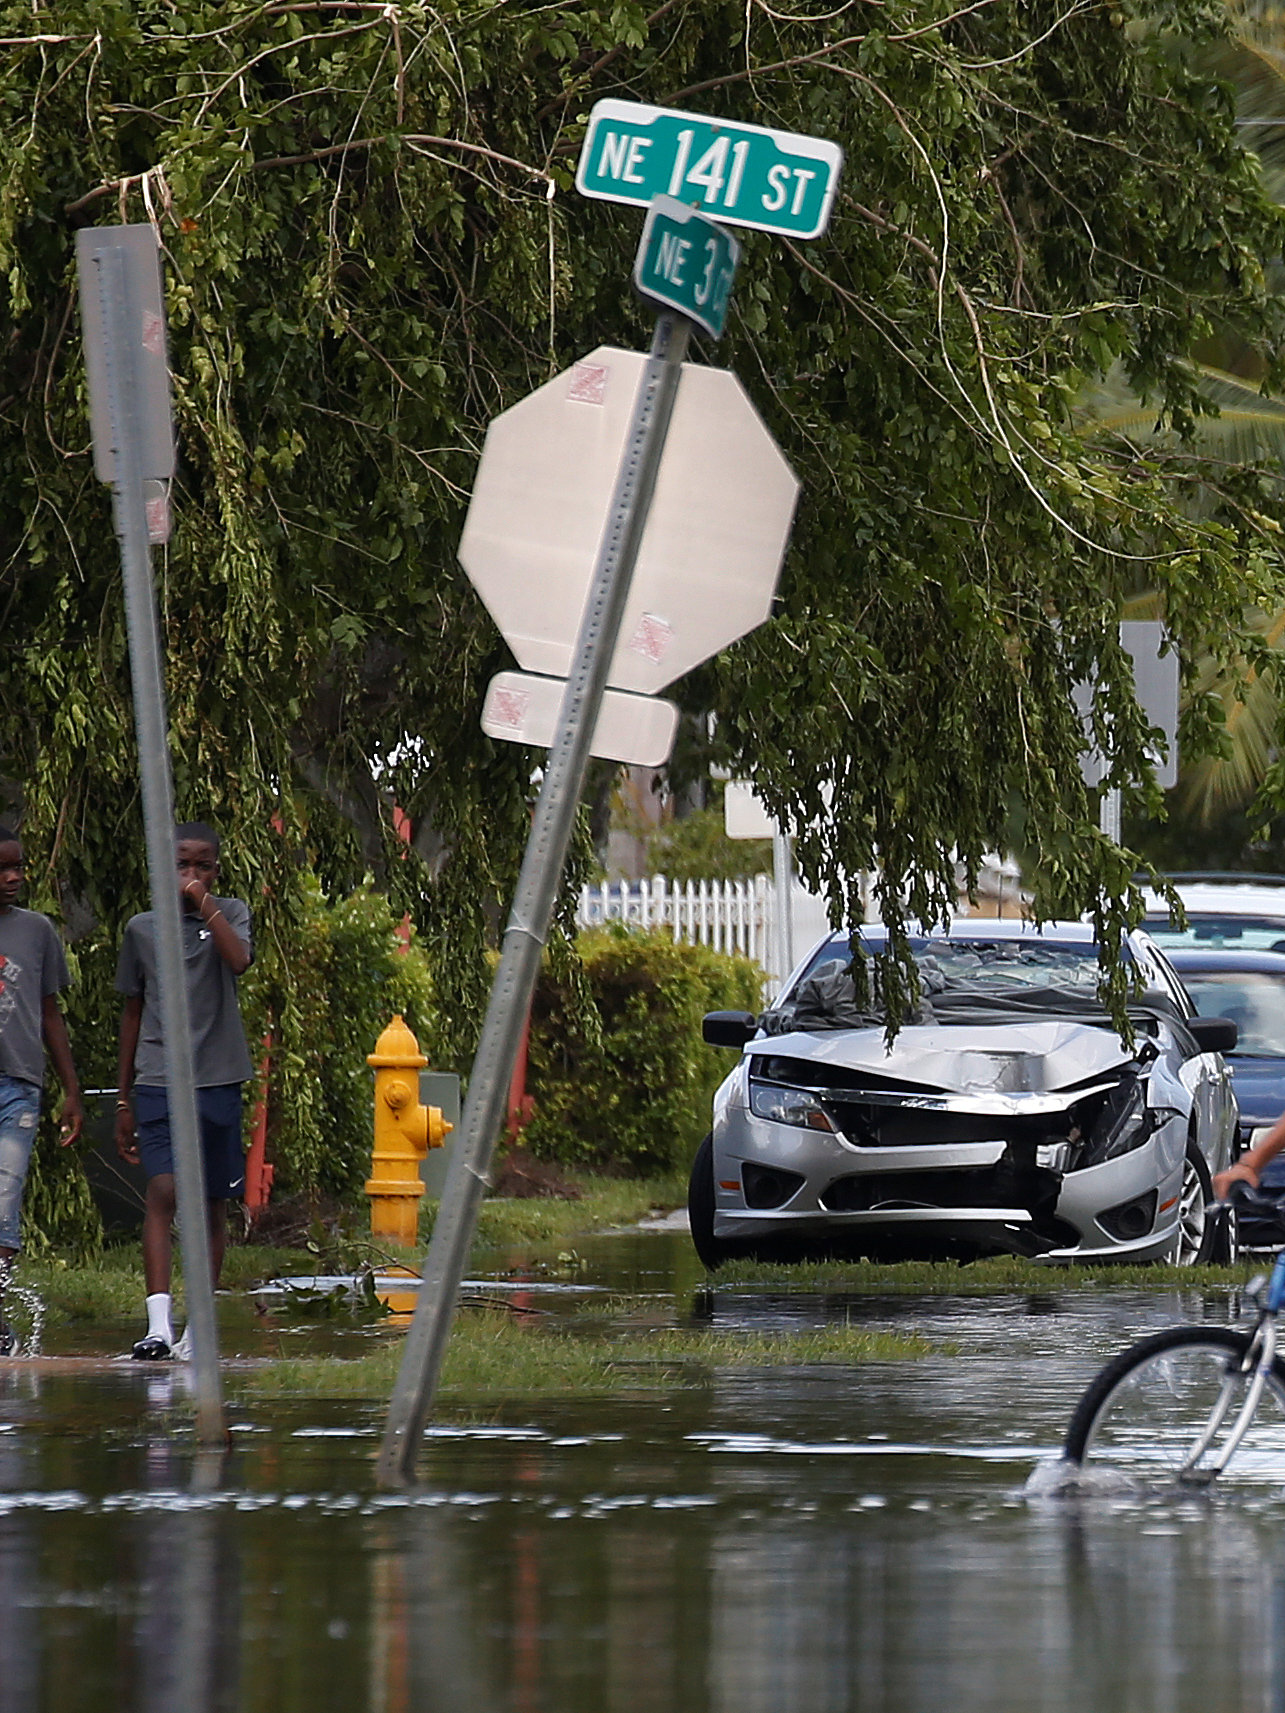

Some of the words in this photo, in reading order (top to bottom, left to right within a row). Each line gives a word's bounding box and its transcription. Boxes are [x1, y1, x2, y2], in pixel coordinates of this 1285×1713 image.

[597, 131, 654, 185] NE
[667, 129, 750, 208] 141
[761, 164, 817, 216] ST
[654, 231, 693, 287] NE
